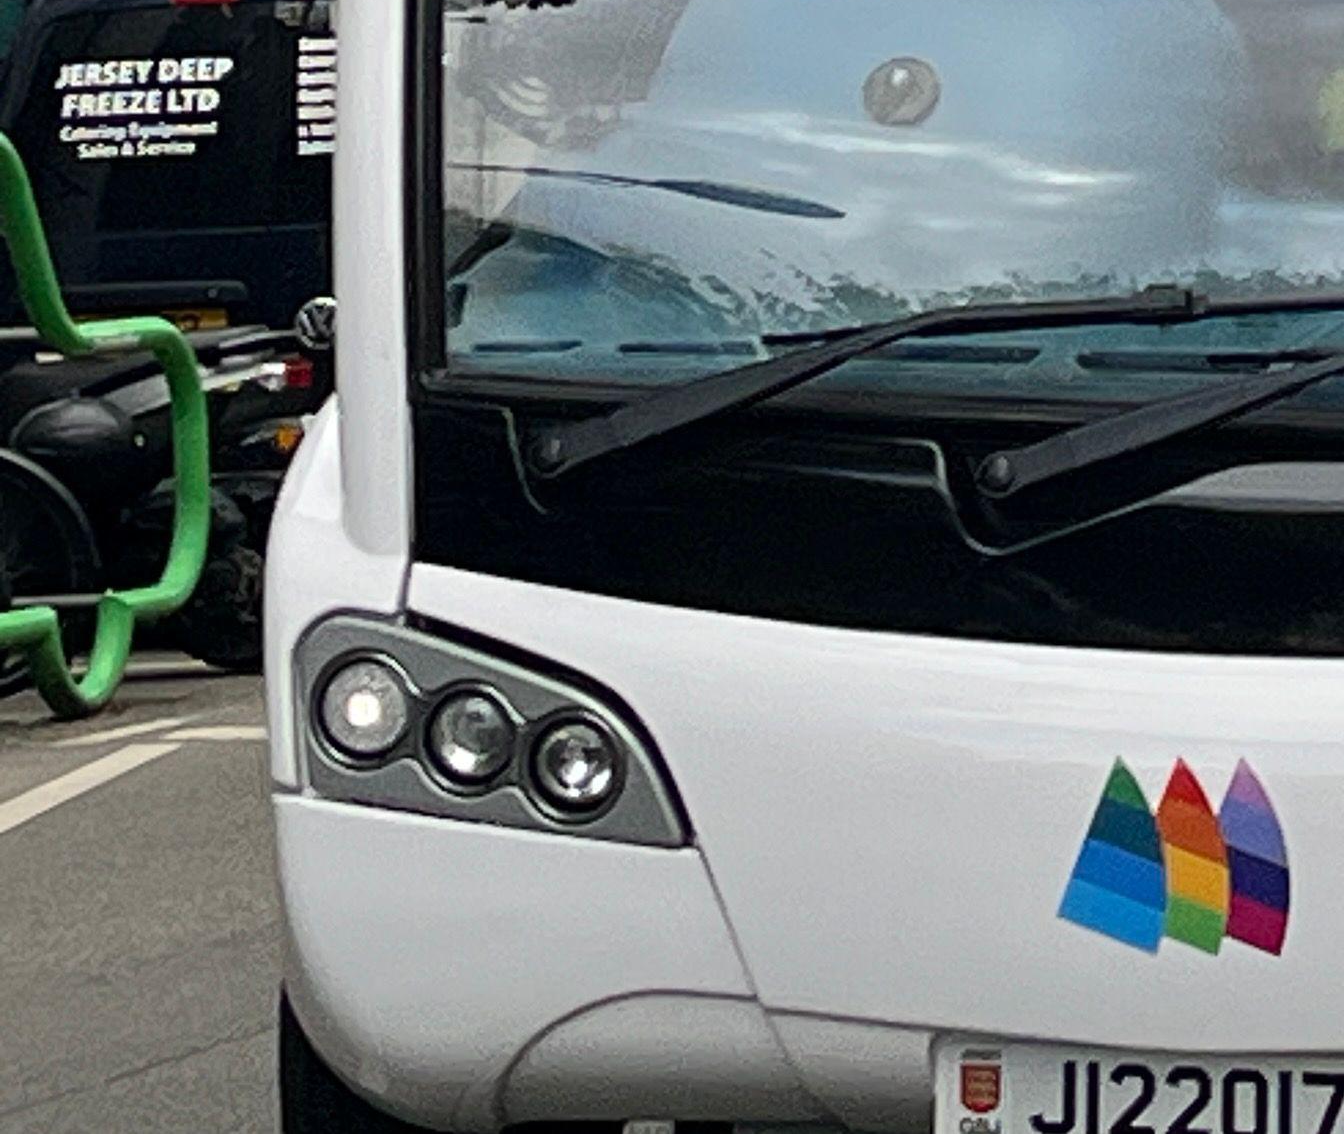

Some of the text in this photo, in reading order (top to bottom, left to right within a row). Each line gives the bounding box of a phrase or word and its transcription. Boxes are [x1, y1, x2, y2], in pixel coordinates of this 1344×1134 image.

[54, 57, 234, 89] JERSEY DEEP
[61, 87, 220, 118] FREEZE LTD
